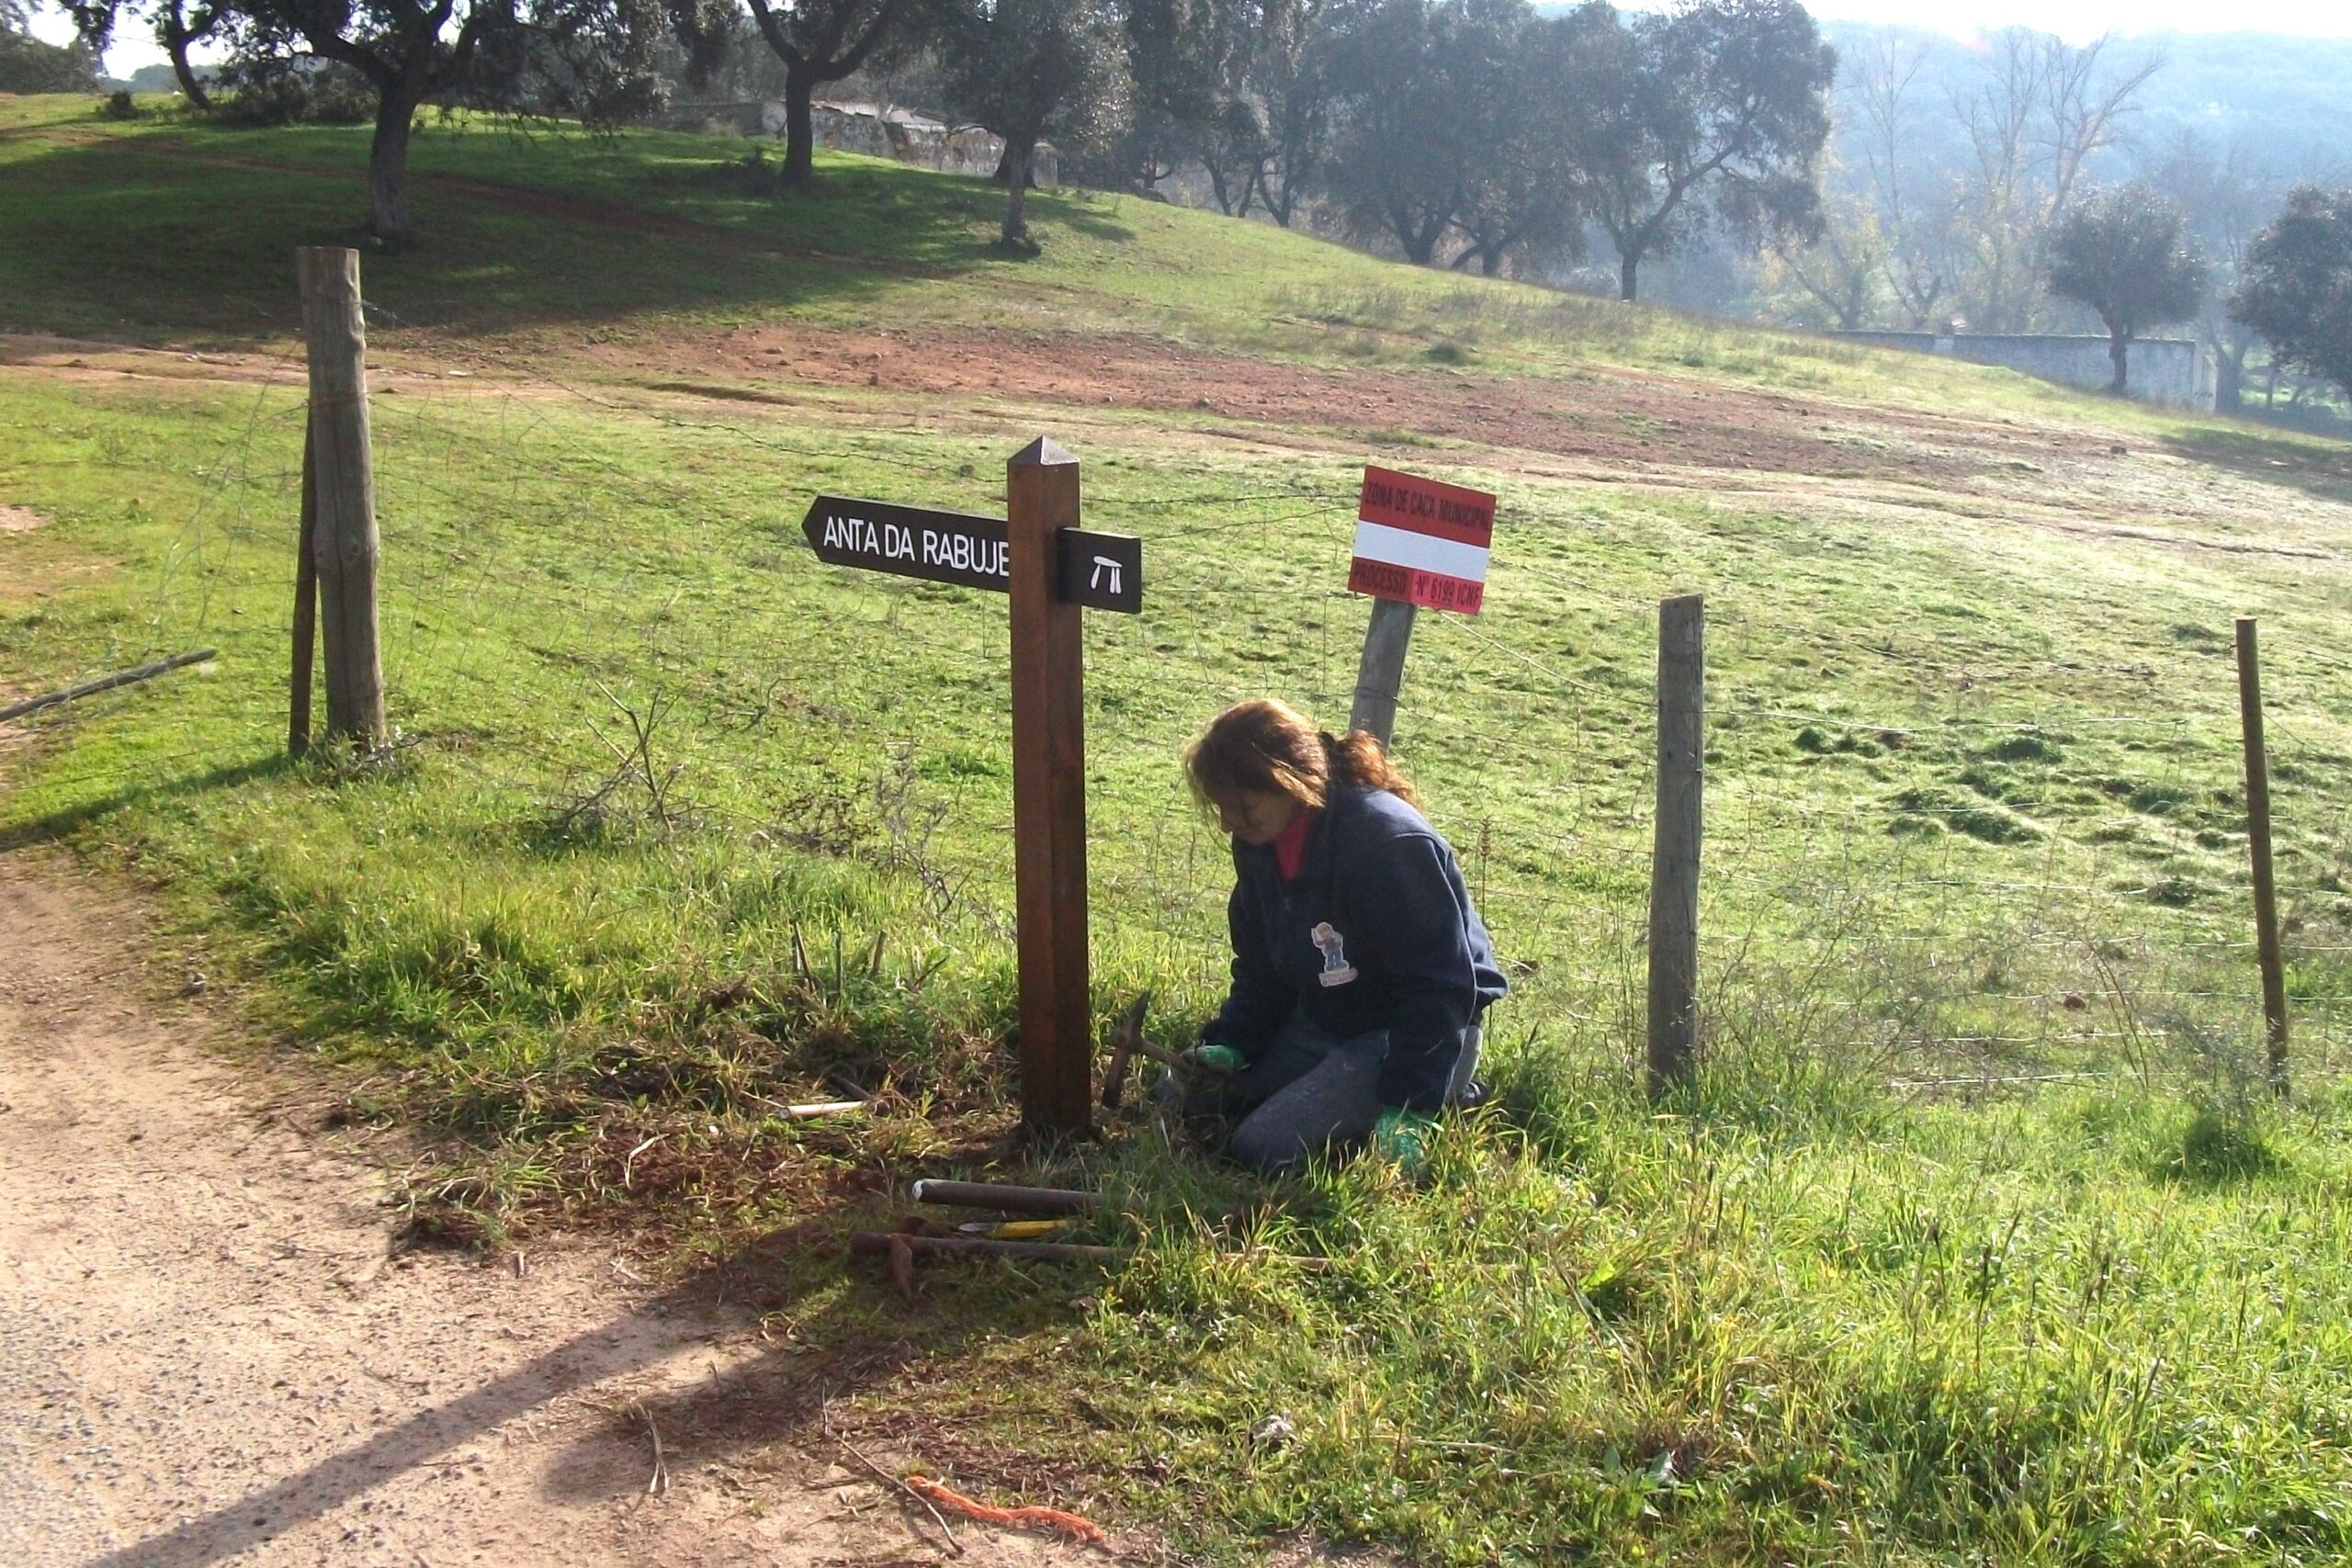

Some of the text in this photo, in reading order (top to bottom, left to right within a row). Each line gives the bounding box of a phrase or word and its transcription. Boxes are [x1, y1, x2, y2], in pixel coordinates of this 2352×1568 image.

[1366, 482, 1392, 509] ZONA
[1395, 488, 1409, 513] DE
[1439, 499, 1493, 530] MUNICIPAL
[823, 516, 1009, 577] ANTA DA RABUJE
[1353, 562, 1408, 594] PROCESSO
[1430, 579, 1455, 604] 6199
[1456, 582, 1481, 608] ICNF
